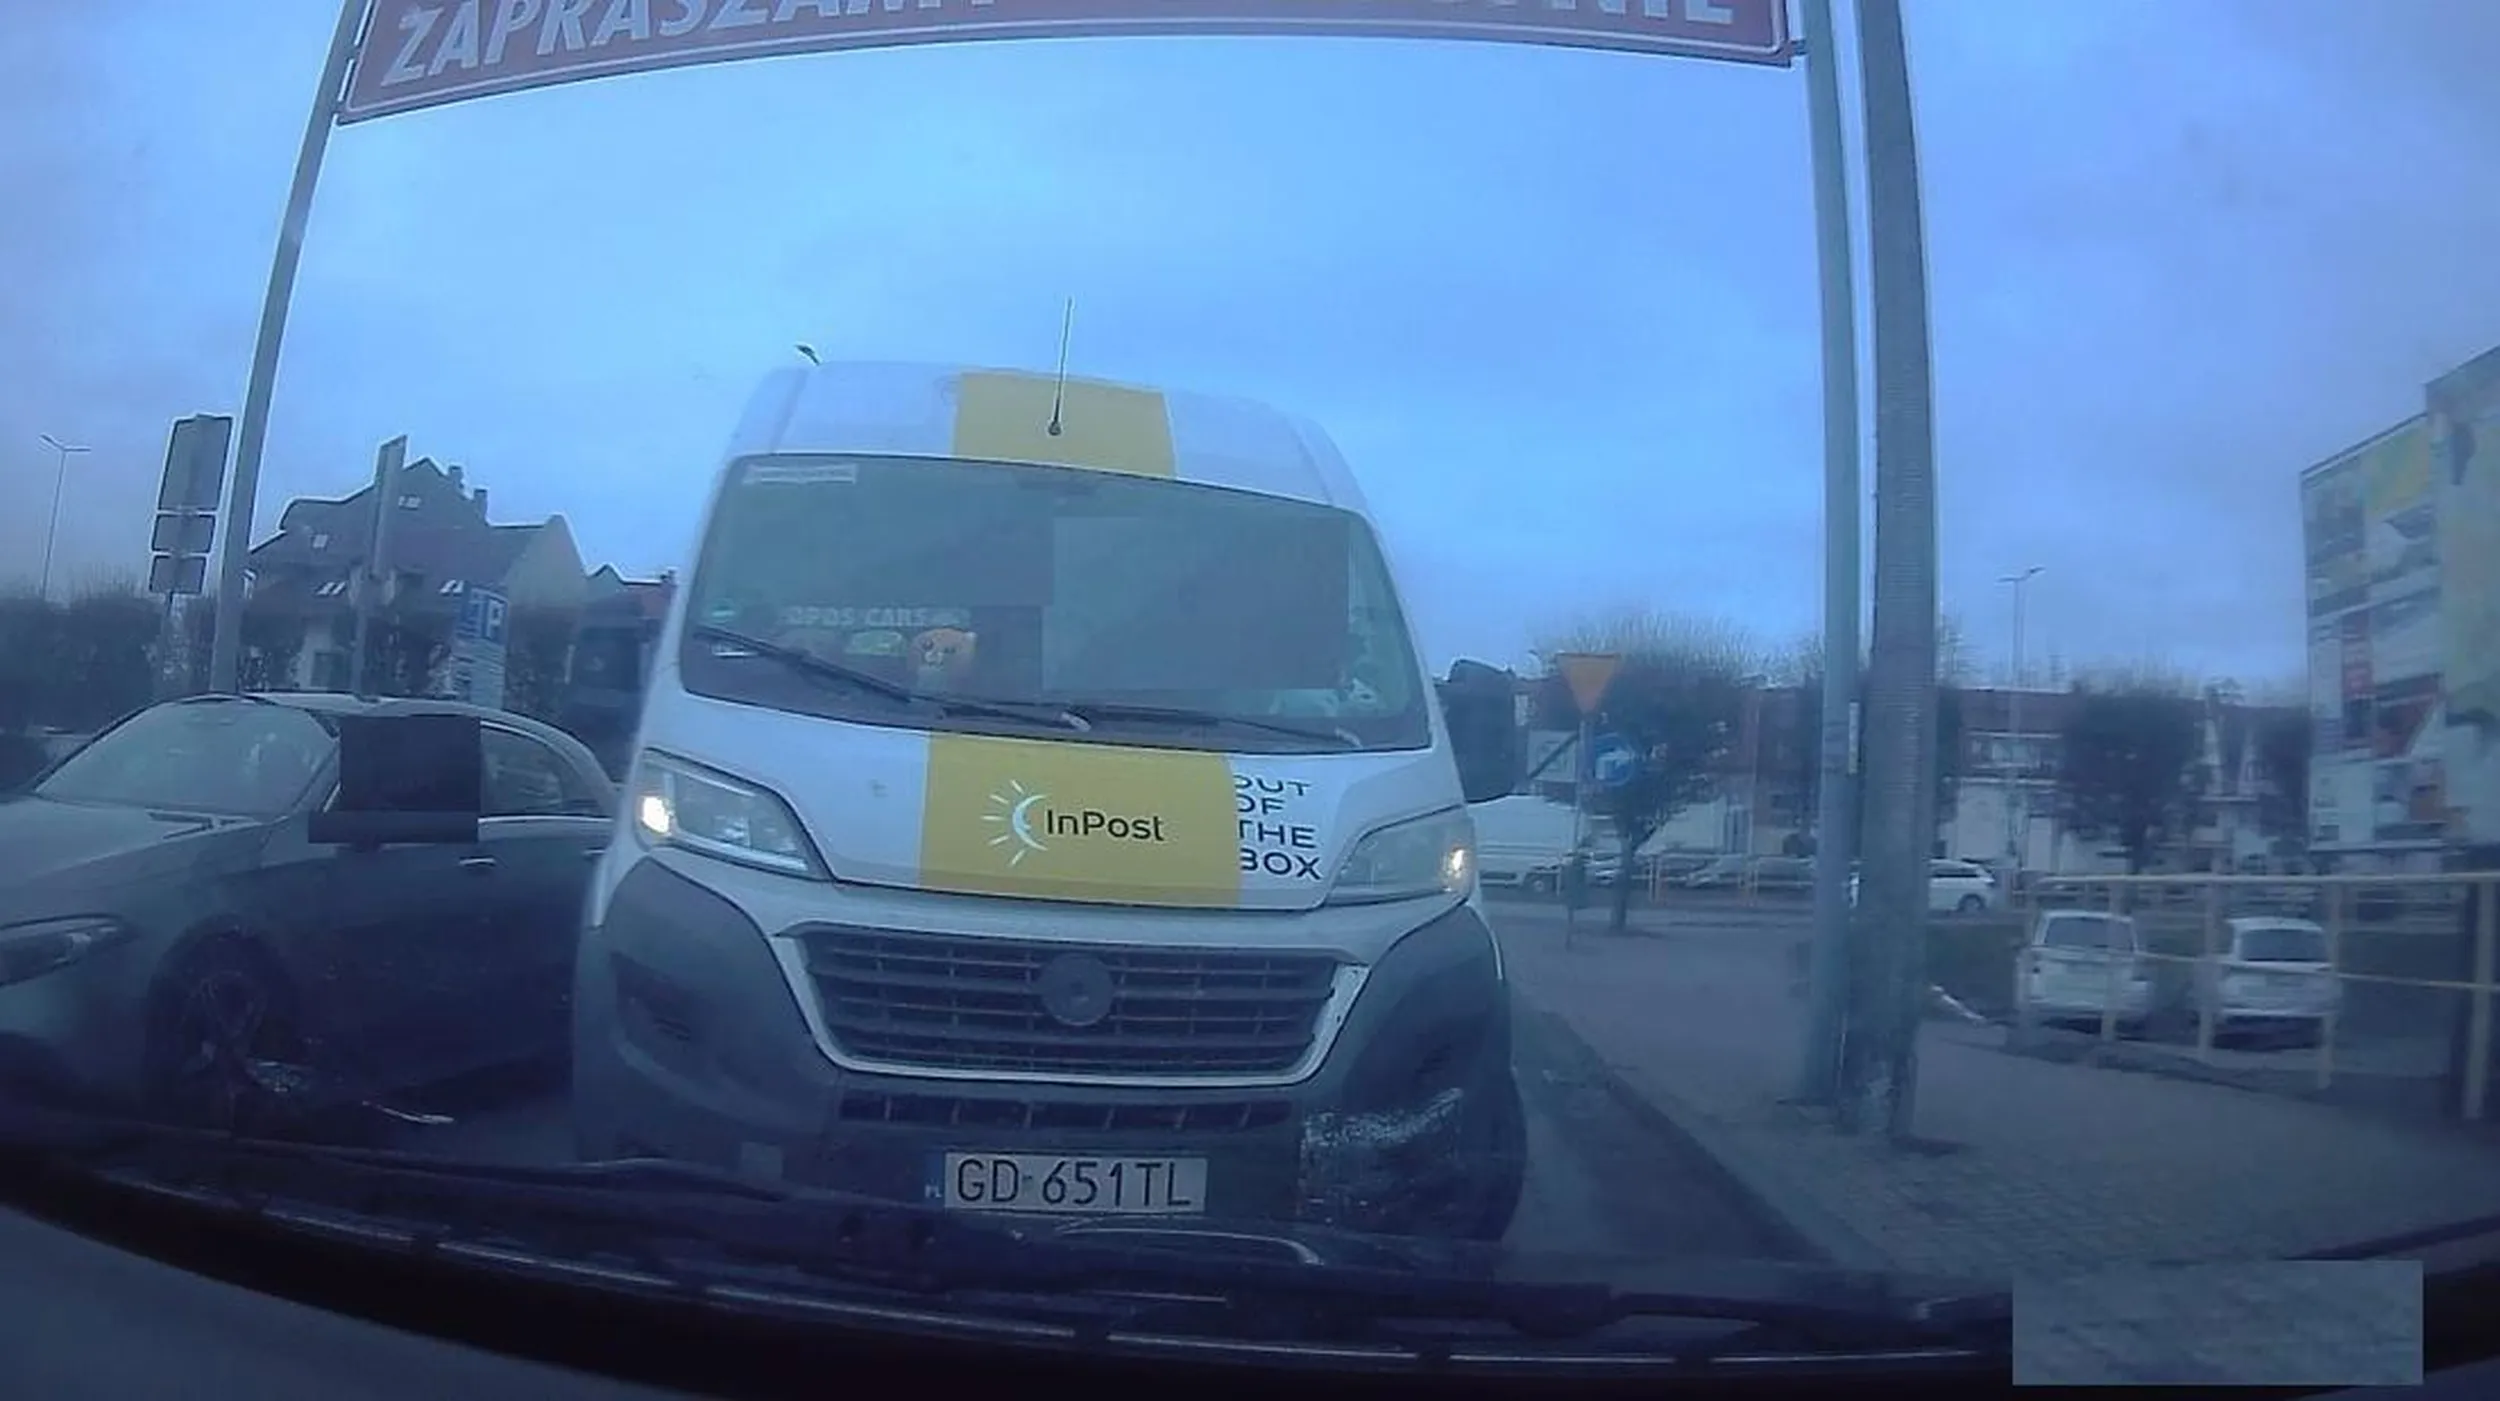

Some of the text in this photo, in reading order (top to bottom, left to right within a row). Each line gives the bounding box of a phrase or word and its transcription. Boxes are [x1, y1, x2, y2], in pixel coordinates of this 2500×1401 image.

[1047, 809, 1164, 841] InPost
[1239, 819, 1316, 849] THE
[1240, 847, 1321, 880] BOX
[957, 1158, 1193, 1207] GD 651TL
